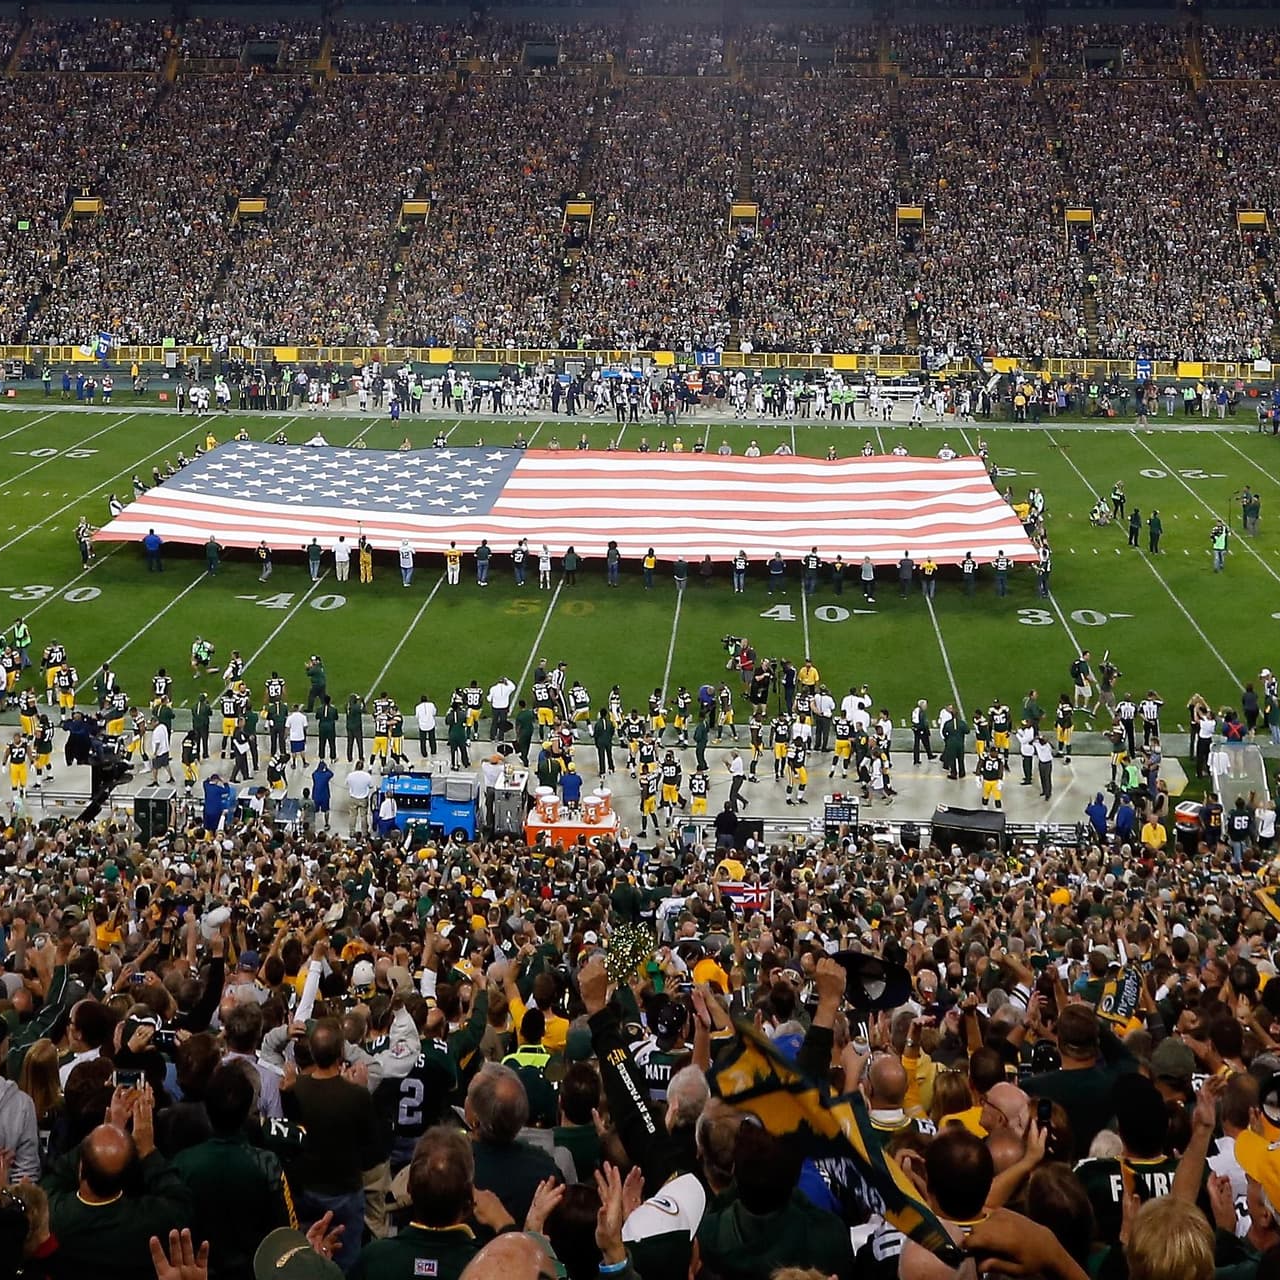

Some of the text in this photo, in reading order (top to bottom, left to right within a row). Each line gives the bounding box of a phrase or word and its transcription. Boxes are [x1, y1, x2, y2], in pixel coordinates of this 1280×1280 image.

[701, 352, 715, 365] 12
[30, 447, 97, 459] 20
[401, 551, 410, 560] 12
[10, 585, 102, 603] 30
[255, 592, 347, 611] 40
[505, 598, 595, 618] 50
[760, 604, 852, 623] 40
[1017, 608, 1110, 627] 30
[59, 675, 69, 686] 61
[155, 682, 166, 695] 17
[269, 684, 281, 697] 83
[467, 693, 480, 706] 88
[223, 702, 235, 715] 81
[375, 720, 387, 733] 12
[836, 724, 850, 736] 53
[985, 760, 999, 771] 64
[691, 778, 705, 793] 33
[1233, 815, 1250, 830] 66
[617, 1062, 640, 1102] PACKERS
[397, 1077, 424, 1125] 2
